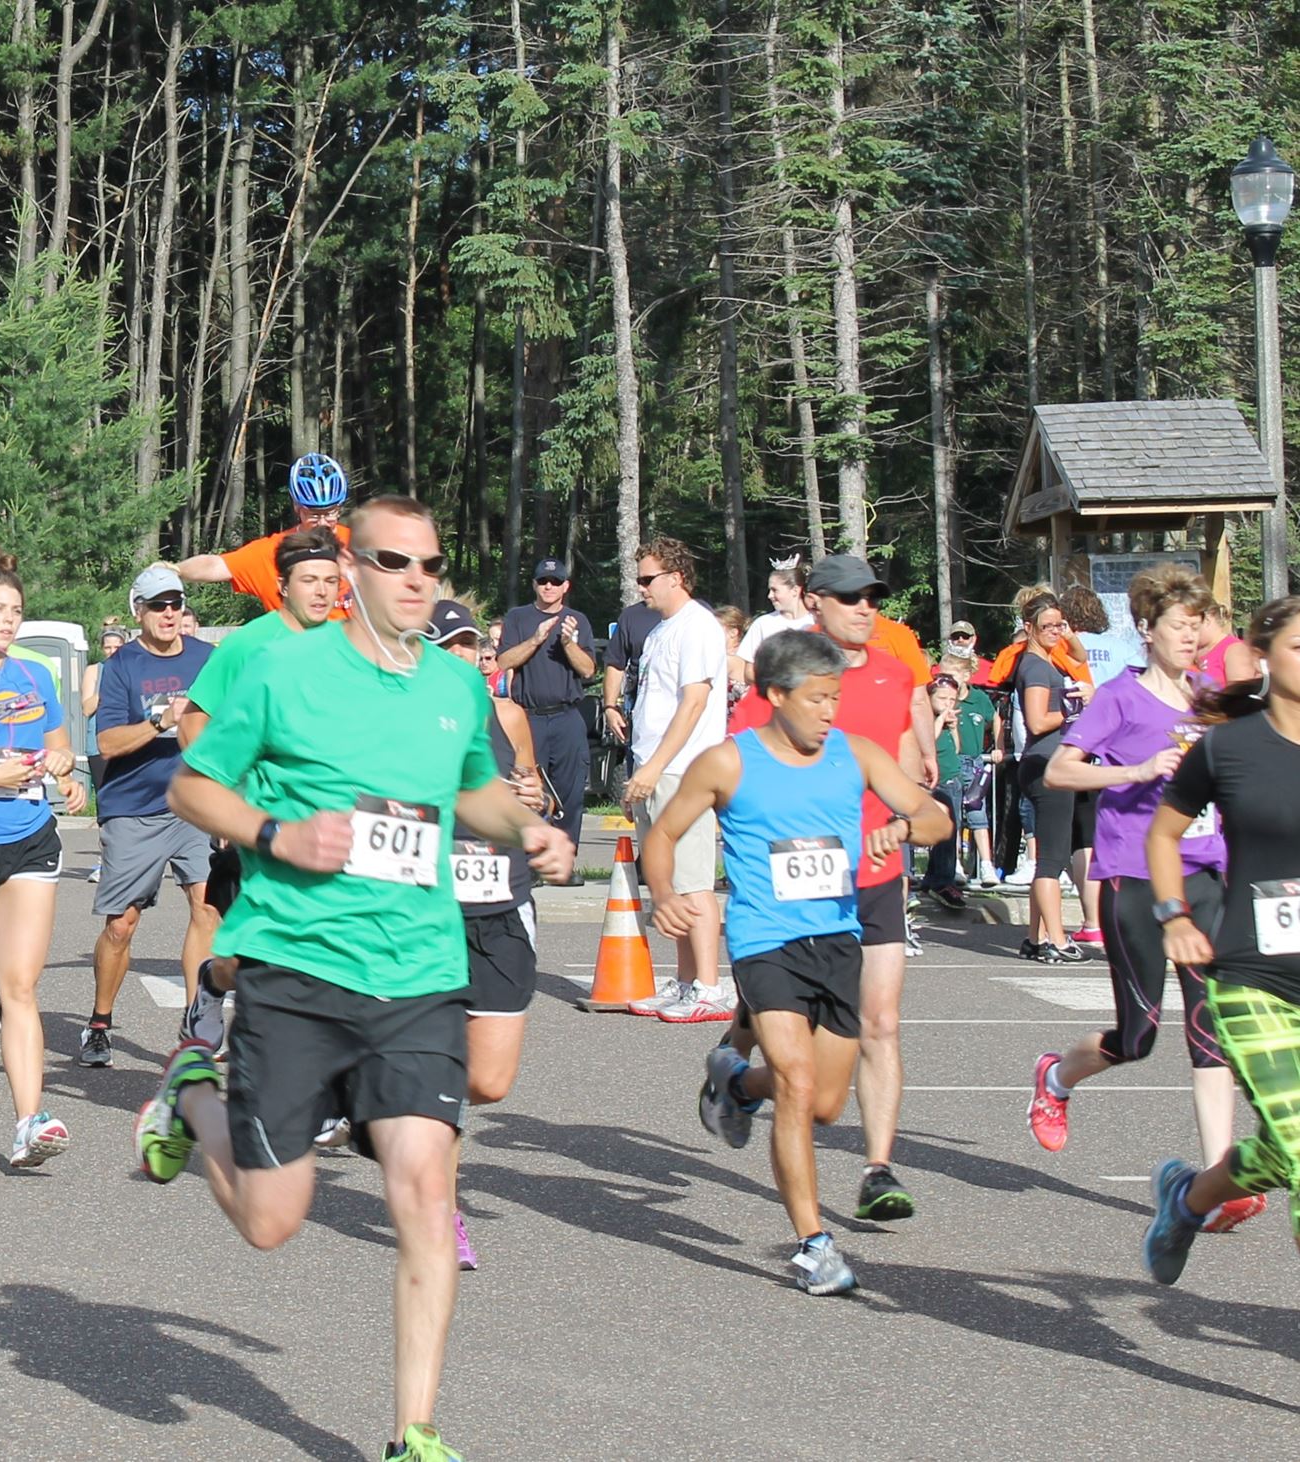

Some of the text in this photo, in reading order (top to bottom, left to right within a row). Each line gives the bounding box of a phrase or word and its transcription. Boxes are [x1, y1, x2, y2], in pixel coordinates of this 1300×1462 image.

[142, 676, 182, 695] RED
[369, 820, 424, 857] 601
[455, 859, 500, 882] 634
[786, 853, 835, 879] 630
